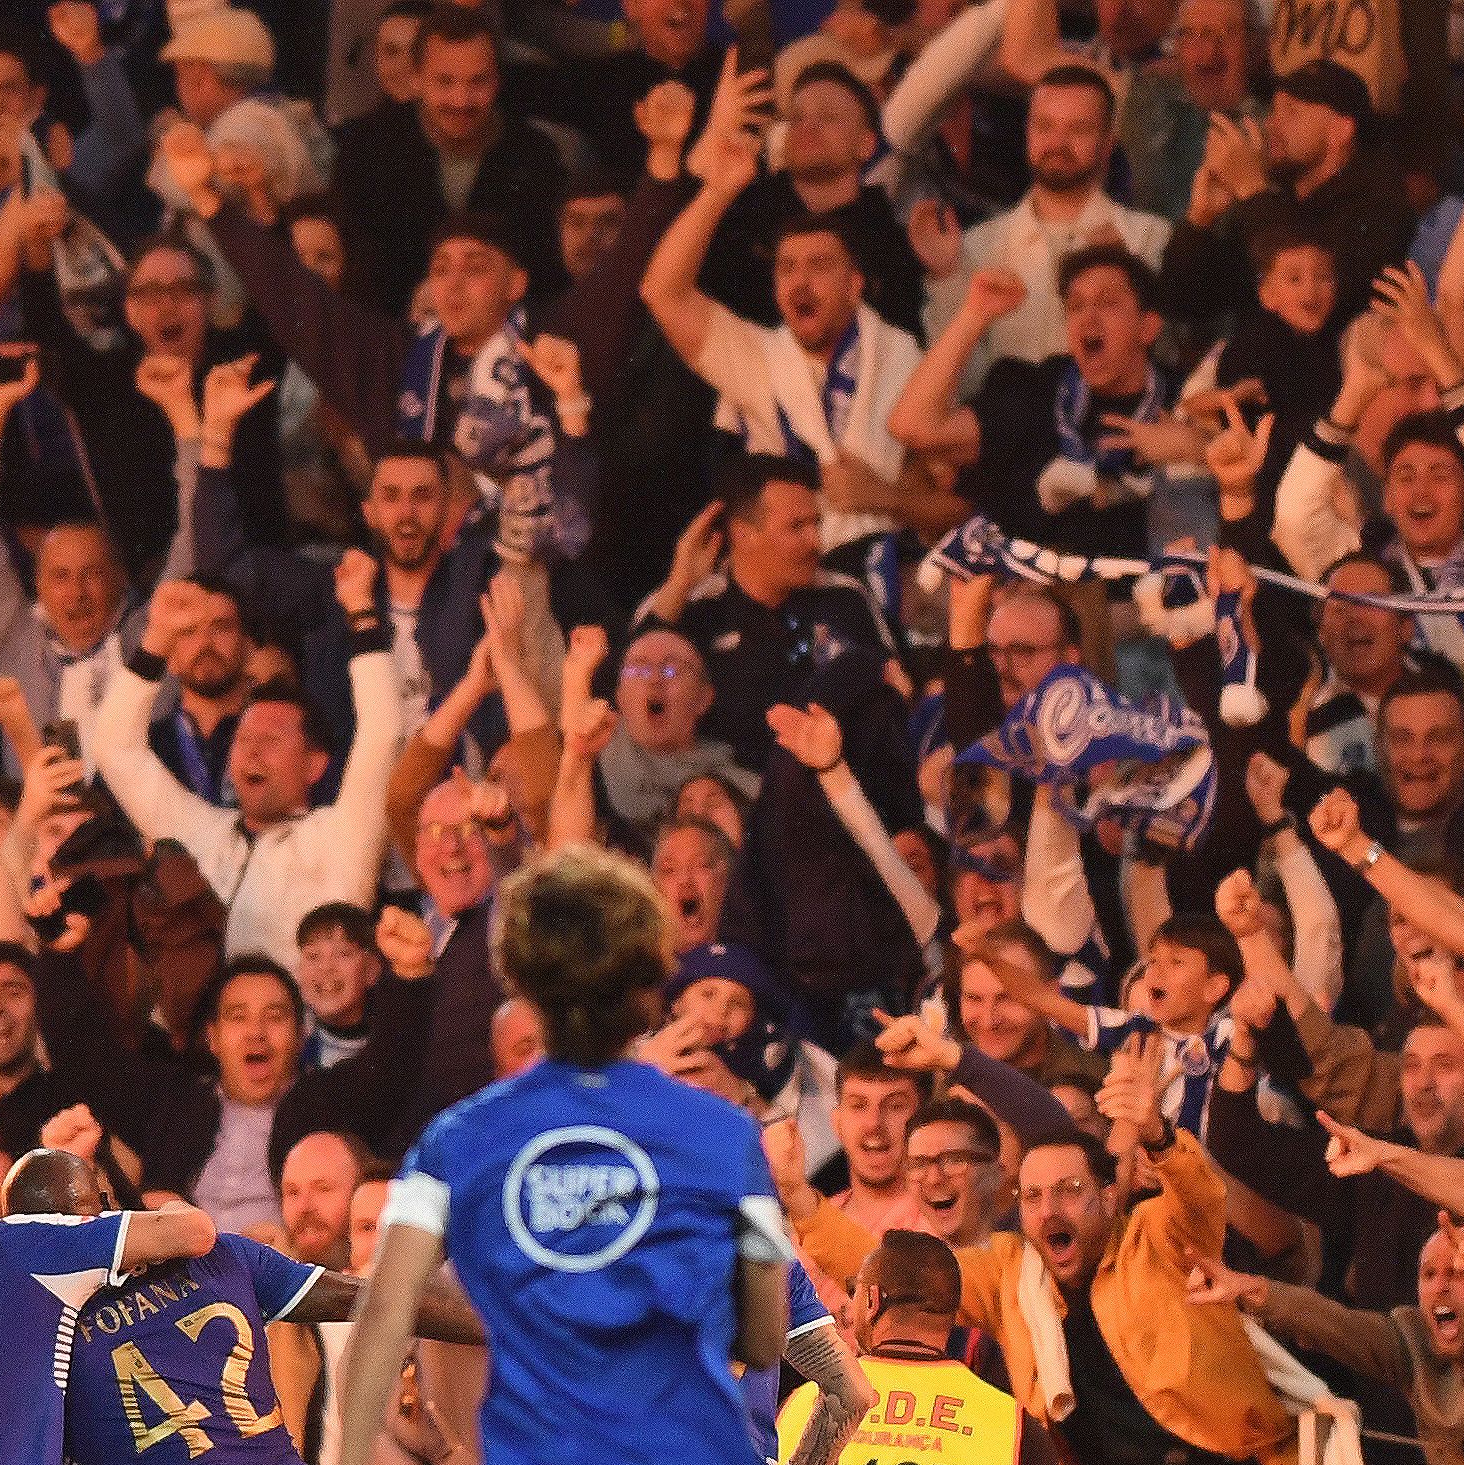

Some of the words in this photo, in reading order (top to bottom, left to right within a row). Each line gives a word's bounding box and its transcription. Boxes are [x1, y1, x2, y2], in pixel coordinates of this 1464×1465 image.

[79, 1278, 201, 1343] FOFANA
[110, 1301, 285, 1460] 42
[870, 1389, 973, 1436] .D.E.
